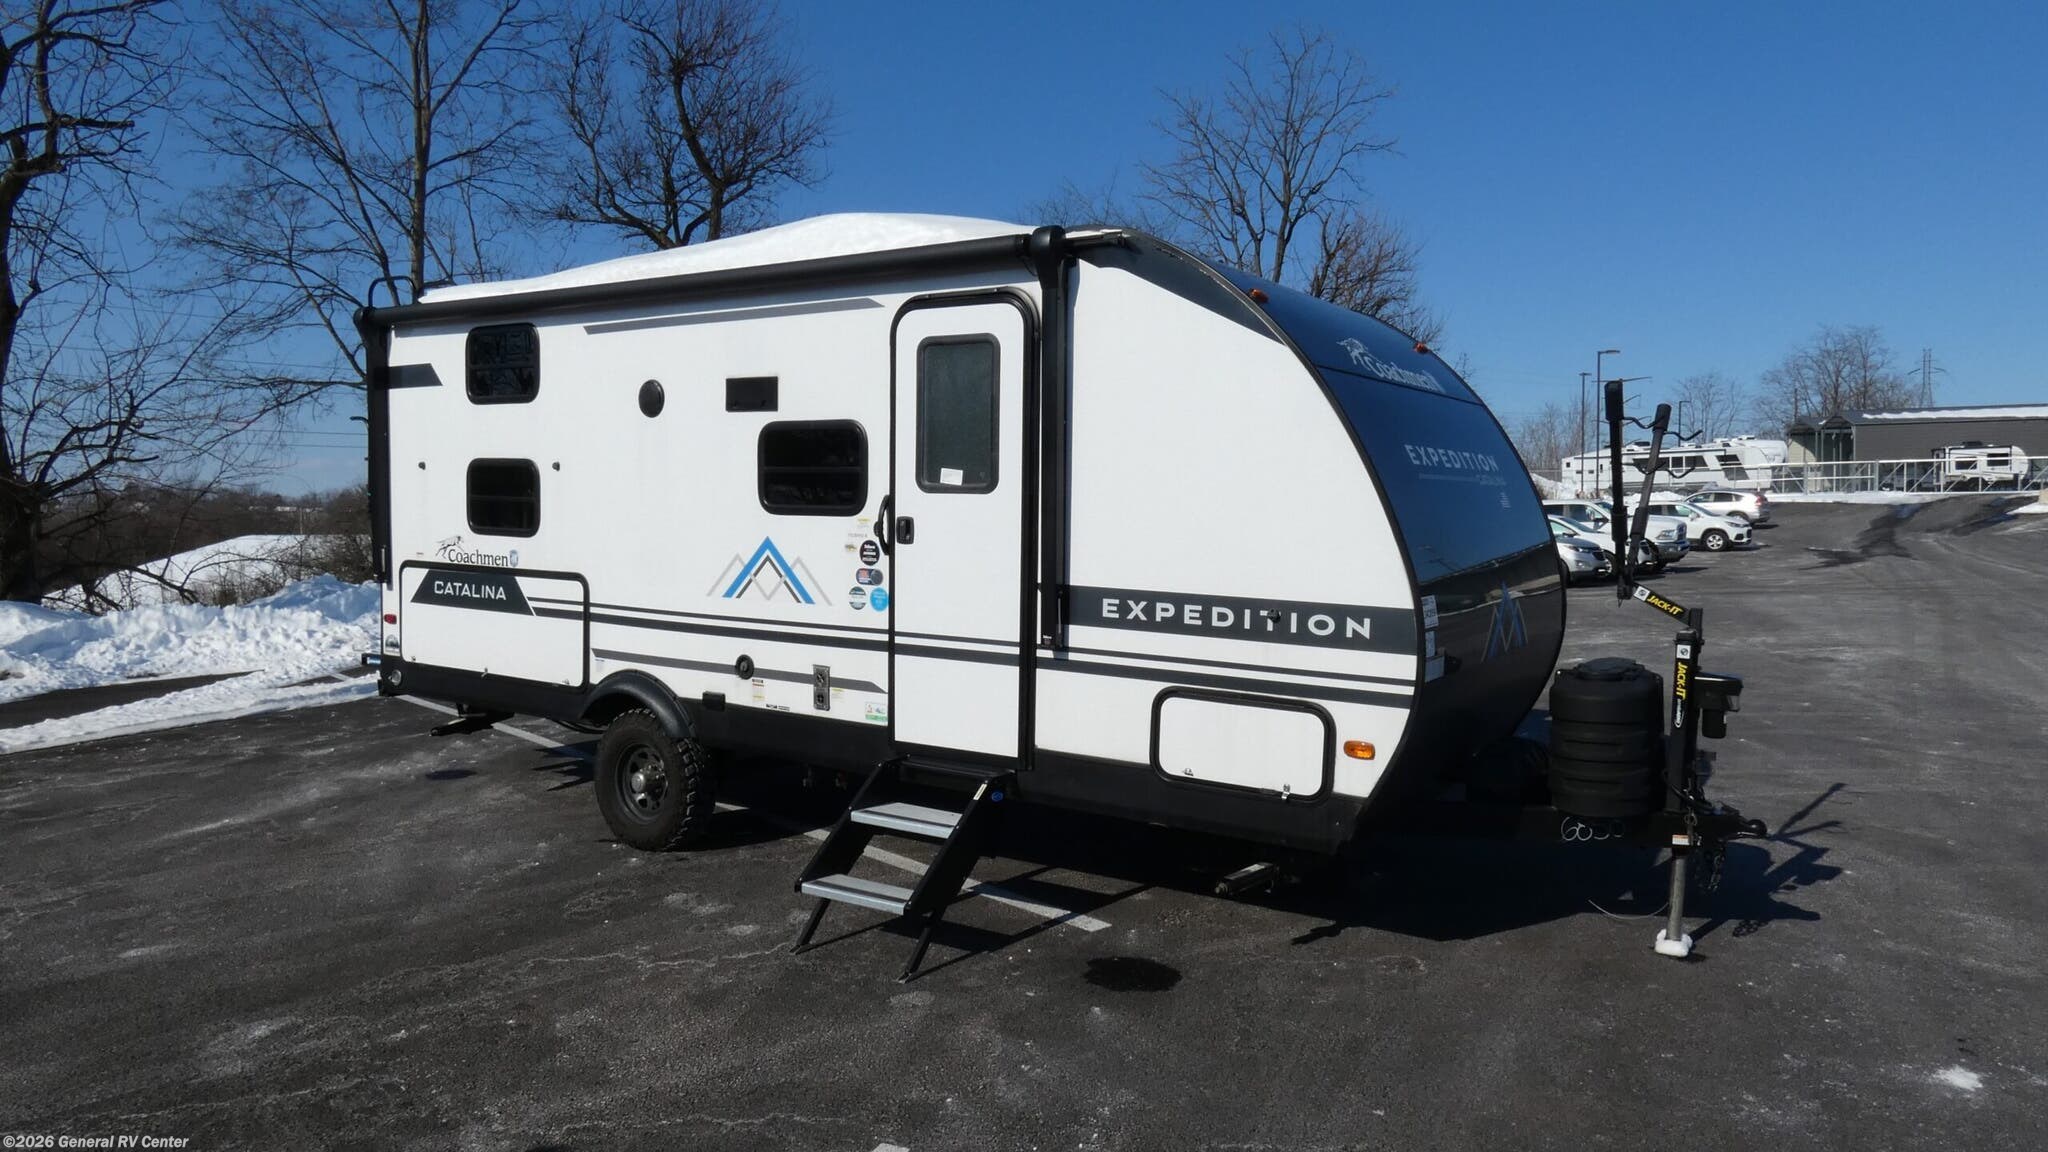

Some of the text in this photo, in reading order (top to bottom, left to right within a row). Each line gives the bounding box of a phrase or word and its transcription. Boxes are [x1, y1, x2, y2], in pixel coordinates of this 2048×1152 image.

[1404, 444, 1500, 472] EXPEDITION
[448, 549, 509, 567] Coachmen
[434, 580, 506, 600] CATALINA
[1647, 595, 1684, 615] JACK-IT
[1102, 597, 1372, 640] EXPEDITION
[1676, 661, 1688, 700] JACK-IT
